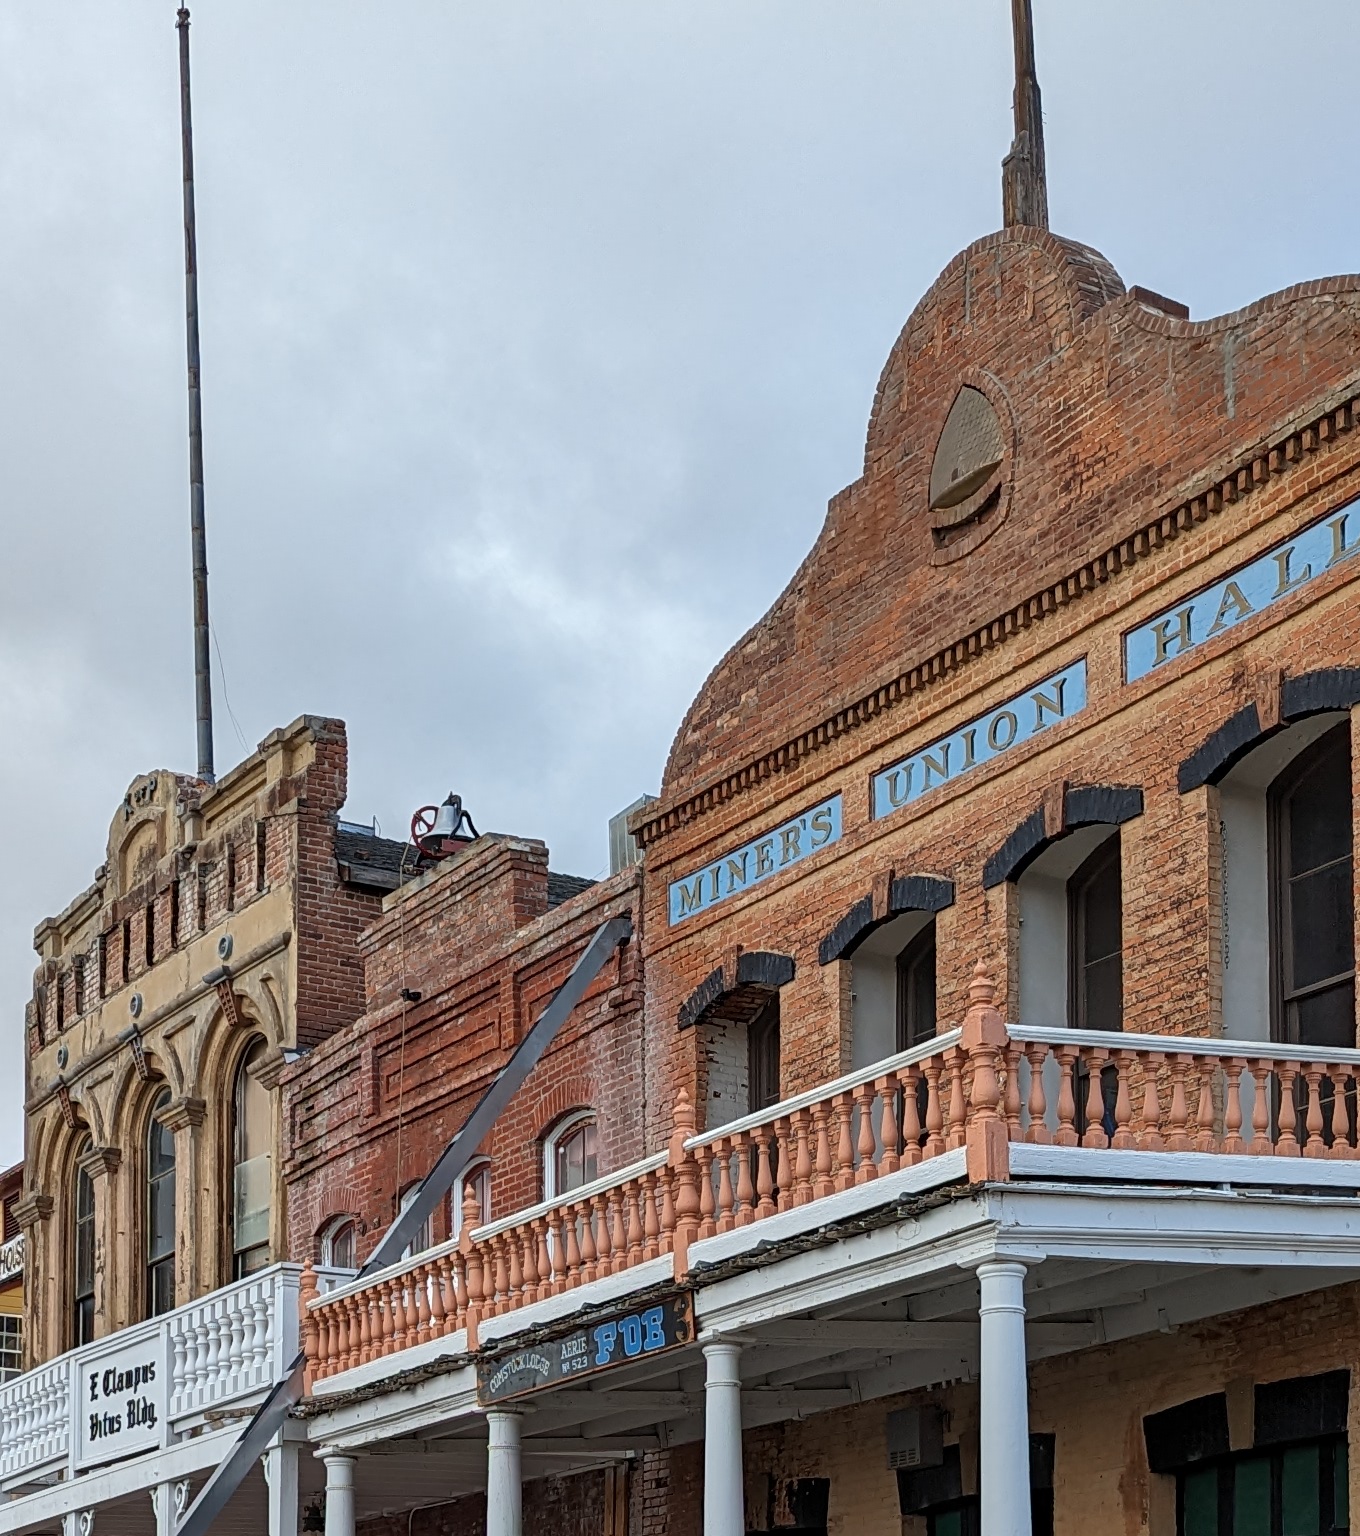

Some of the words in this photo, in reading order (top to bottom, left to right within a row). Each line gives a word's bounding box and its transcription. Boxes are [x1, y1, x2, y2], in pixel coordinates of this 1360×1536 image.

[678, 807, 832, 917] MINER'S
[885, 677, 1067, 807] UNION
[561, 1337, 588, 1359] AERIE
[594, 1306, 665, 1365] FOE
[90, 1372, 99, 1402] E
[103, 1361, 156, 1397] Clampus
[490, 1356, 525, 1393] COMSTOCK
[526, 1353, 550, 1376] LODGE
[572, 1356, 588, 1370] 523
[90, 1411, 122, 1441] Vitus
